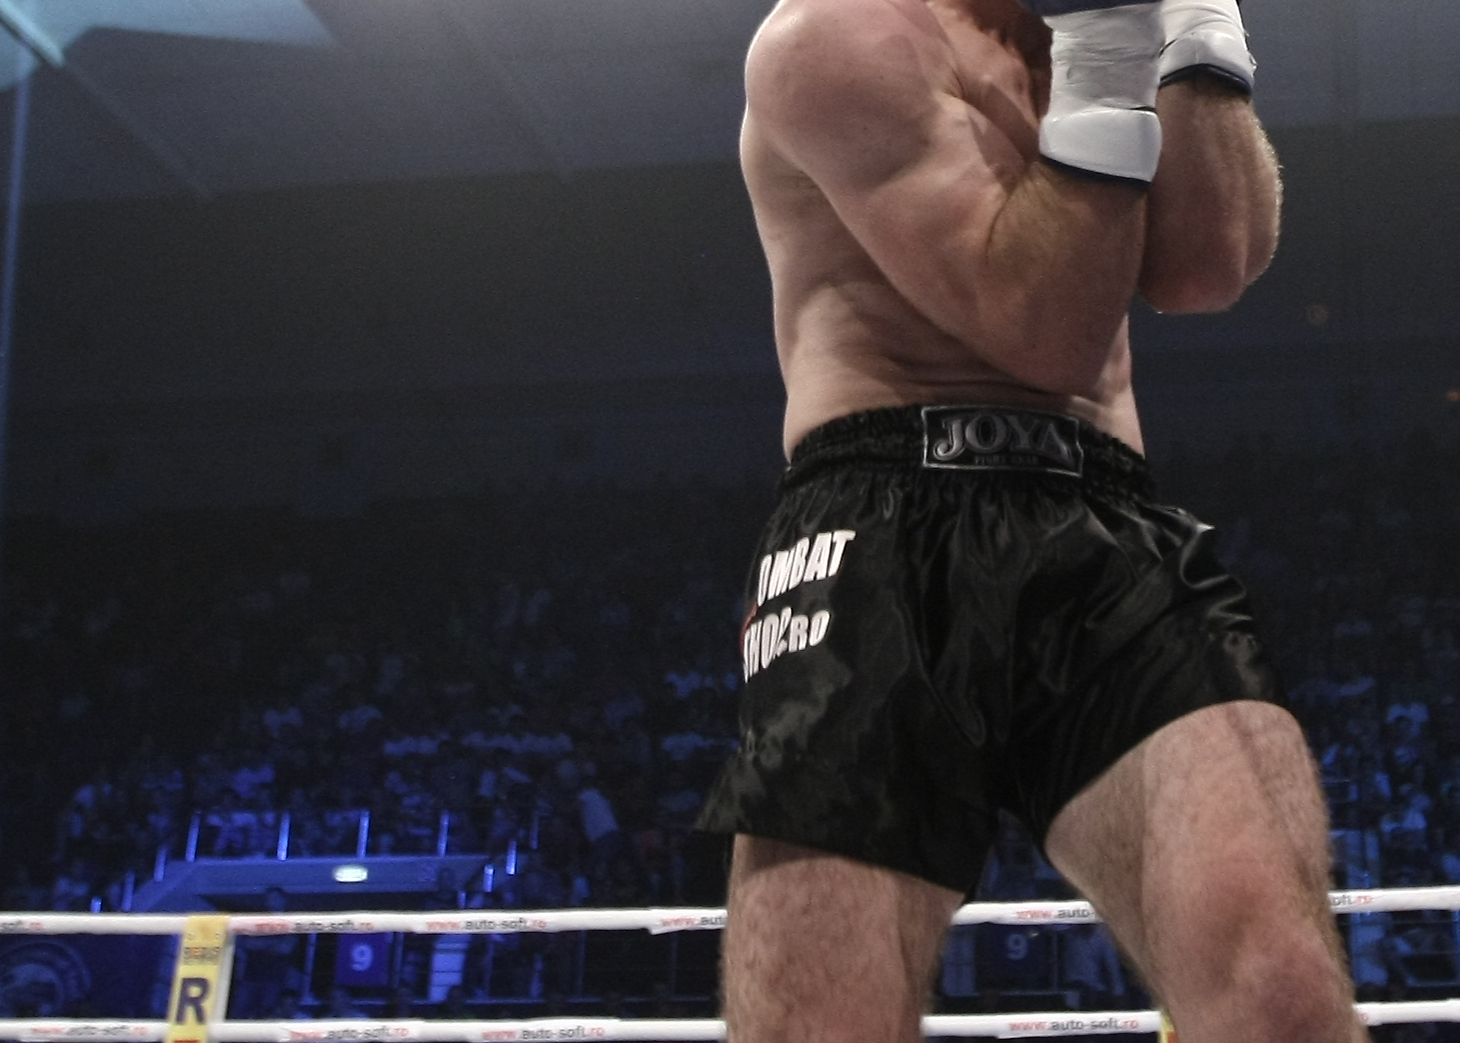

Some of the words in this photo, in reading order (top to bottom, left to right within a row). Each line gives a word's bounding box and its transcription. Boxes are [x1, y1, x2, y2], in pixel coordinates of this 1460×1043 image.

[933, 413, 1077, 468] JOYA
[757, 529, 857, 607] OMBAT
[351, 942, 374, 972] 9
[1006, 933, 1028, 961] 9
[176, 976, 210, 1025] R
[482, 1026, 606, 1042] www.auto-soft.ro
[1009, 1017, 1140, 1032] www.auto-soft.ro
